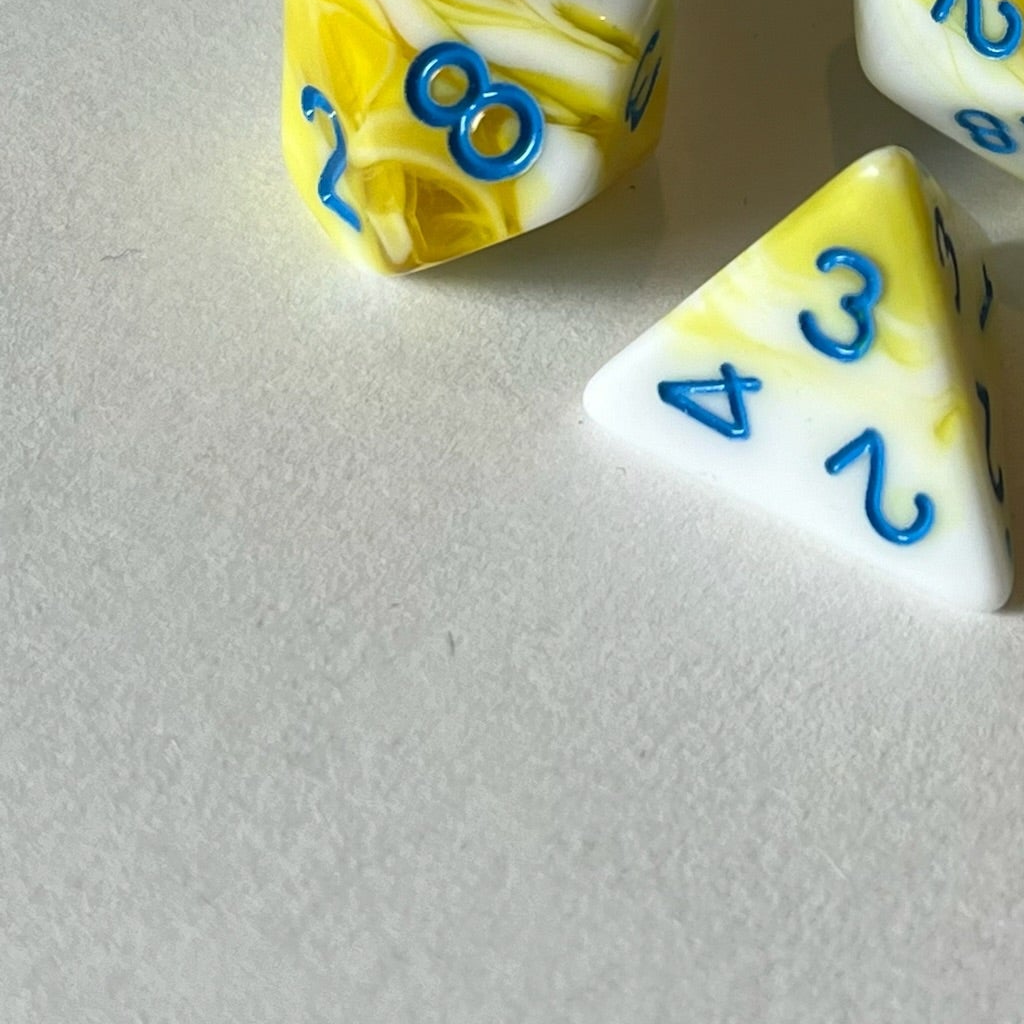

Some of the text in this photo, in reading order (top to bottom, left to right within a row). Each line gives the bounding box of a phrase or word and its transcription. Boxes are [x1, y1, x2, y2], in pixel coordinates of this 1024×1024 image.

[300, 84, 363, 233] 2
[404, 40, 547, 182] 8
[799, 246, 884, 363] 3
[657, 361, 763, 440] 4
[824, 426, 937, 547] 2
